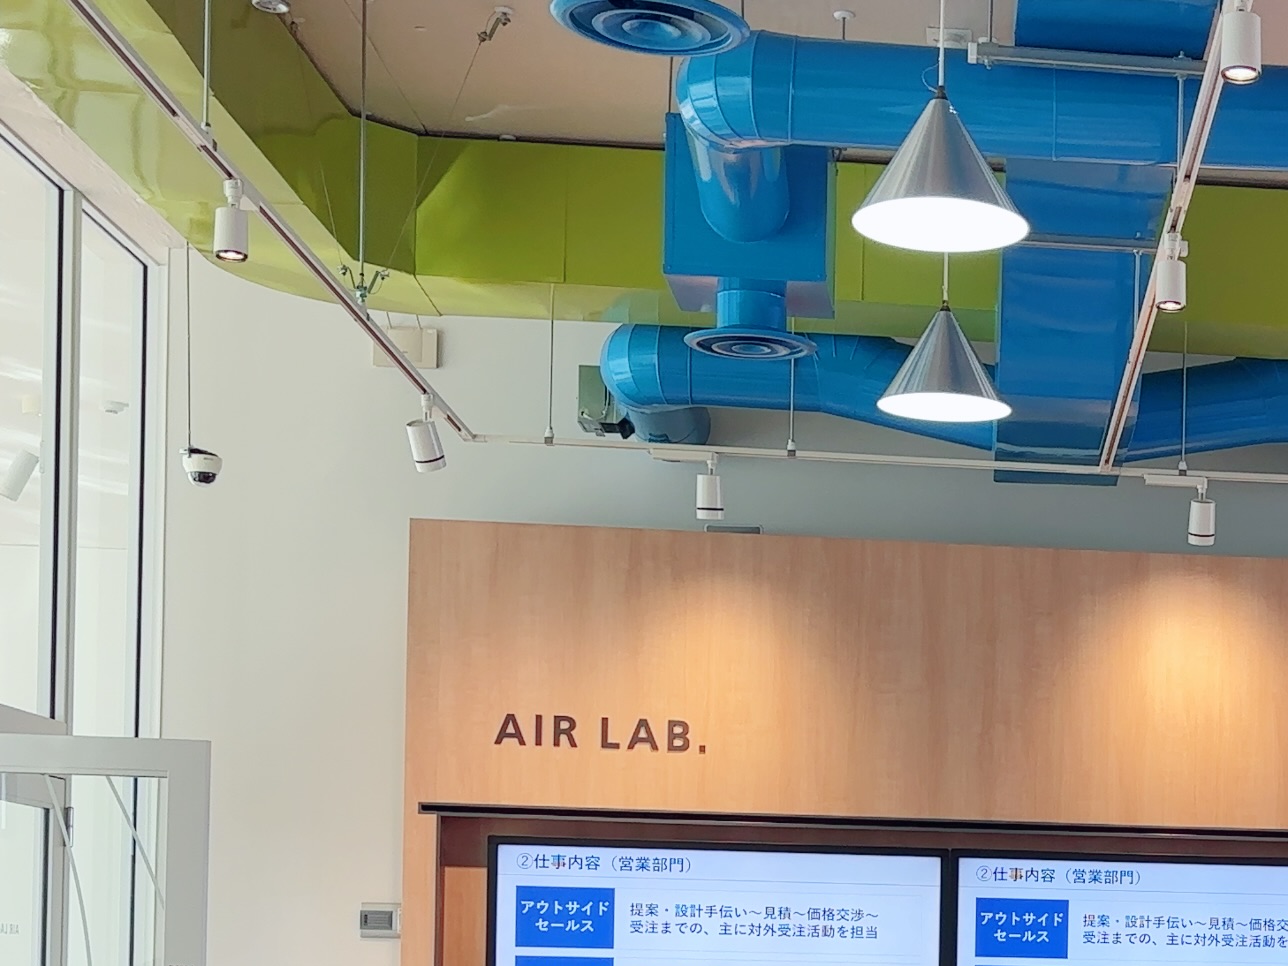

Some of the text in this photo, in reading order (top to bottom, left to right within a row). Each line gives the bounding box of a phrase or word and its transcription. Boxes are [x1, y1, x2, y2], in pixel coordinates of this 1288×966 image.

[494, 713, 706, 755] AIR LAB.
[521, 900, 609, 916] アウトサイド
[535, 918, 594, 932] セールス
[981, 912, 1063, 926] アウトサイド
[994, 929, 1049, 942] セールス
